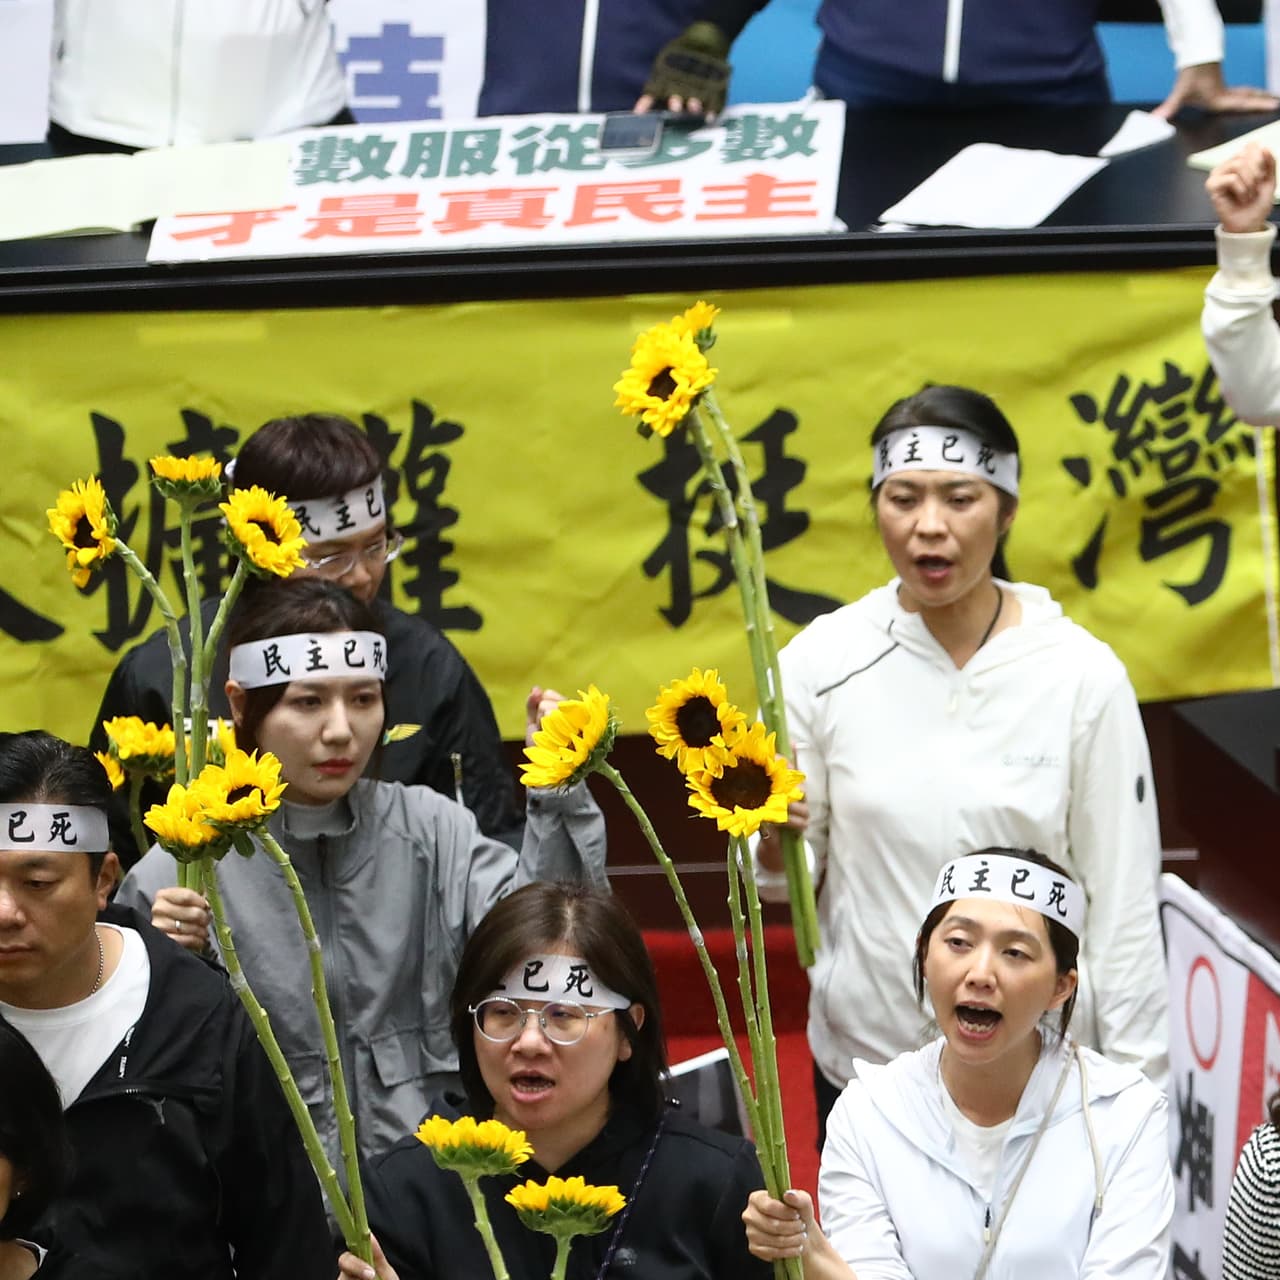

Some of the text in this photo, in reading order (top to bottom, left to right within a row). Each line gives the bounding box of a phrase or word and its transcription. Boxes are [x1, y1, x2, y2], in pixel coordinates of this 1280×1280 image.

[169, 171, 820, 247] 才是真民主
[263, 640, 386, 678] 民主已死
[7, 810, 78, 846] 已死
[939, 861, 1068, 917] 民主已死
[500, 960, 594, 998] 已死
